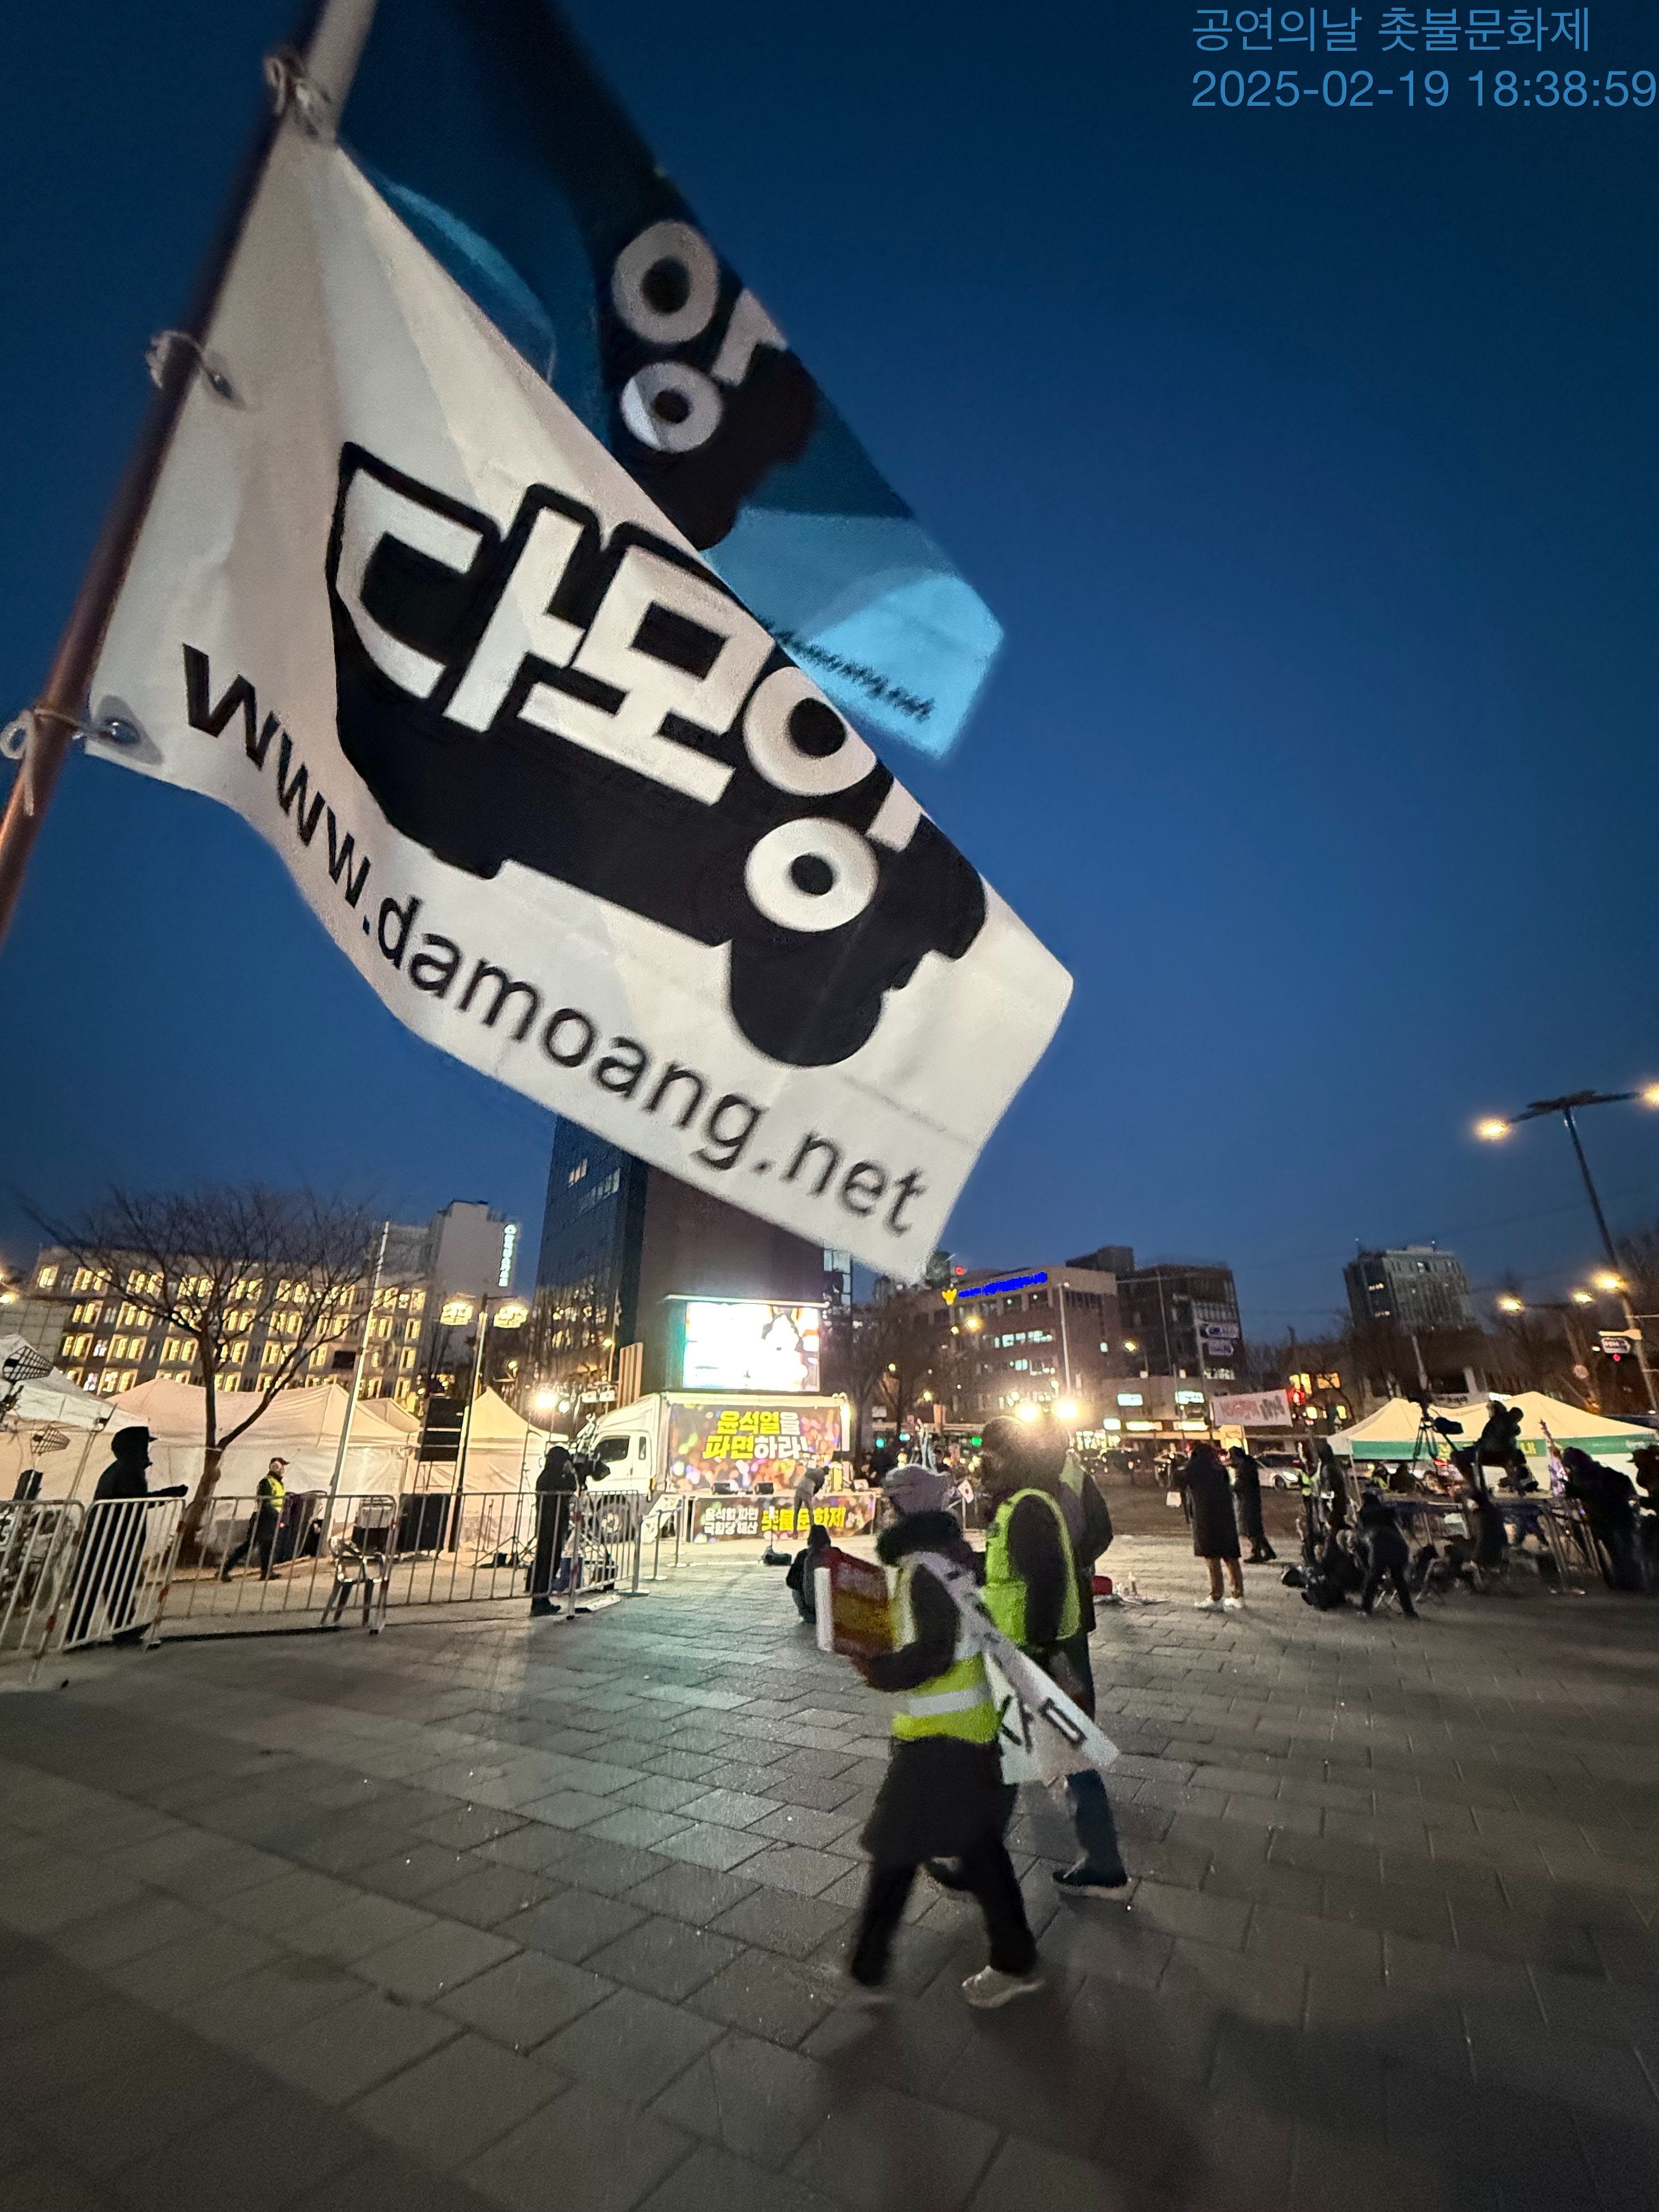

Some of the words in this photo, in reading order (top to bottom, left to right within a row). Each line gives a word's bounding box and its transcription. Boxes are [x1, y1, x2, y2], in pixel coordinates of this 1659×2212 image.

[331, 466, 927, 933] 다모앙
[182, 643, 927, 1237] www.damoang.net
[702, 1435, 809, 1459] 파면하라!
[716, 1410, 800, 1435] 윤석열을
